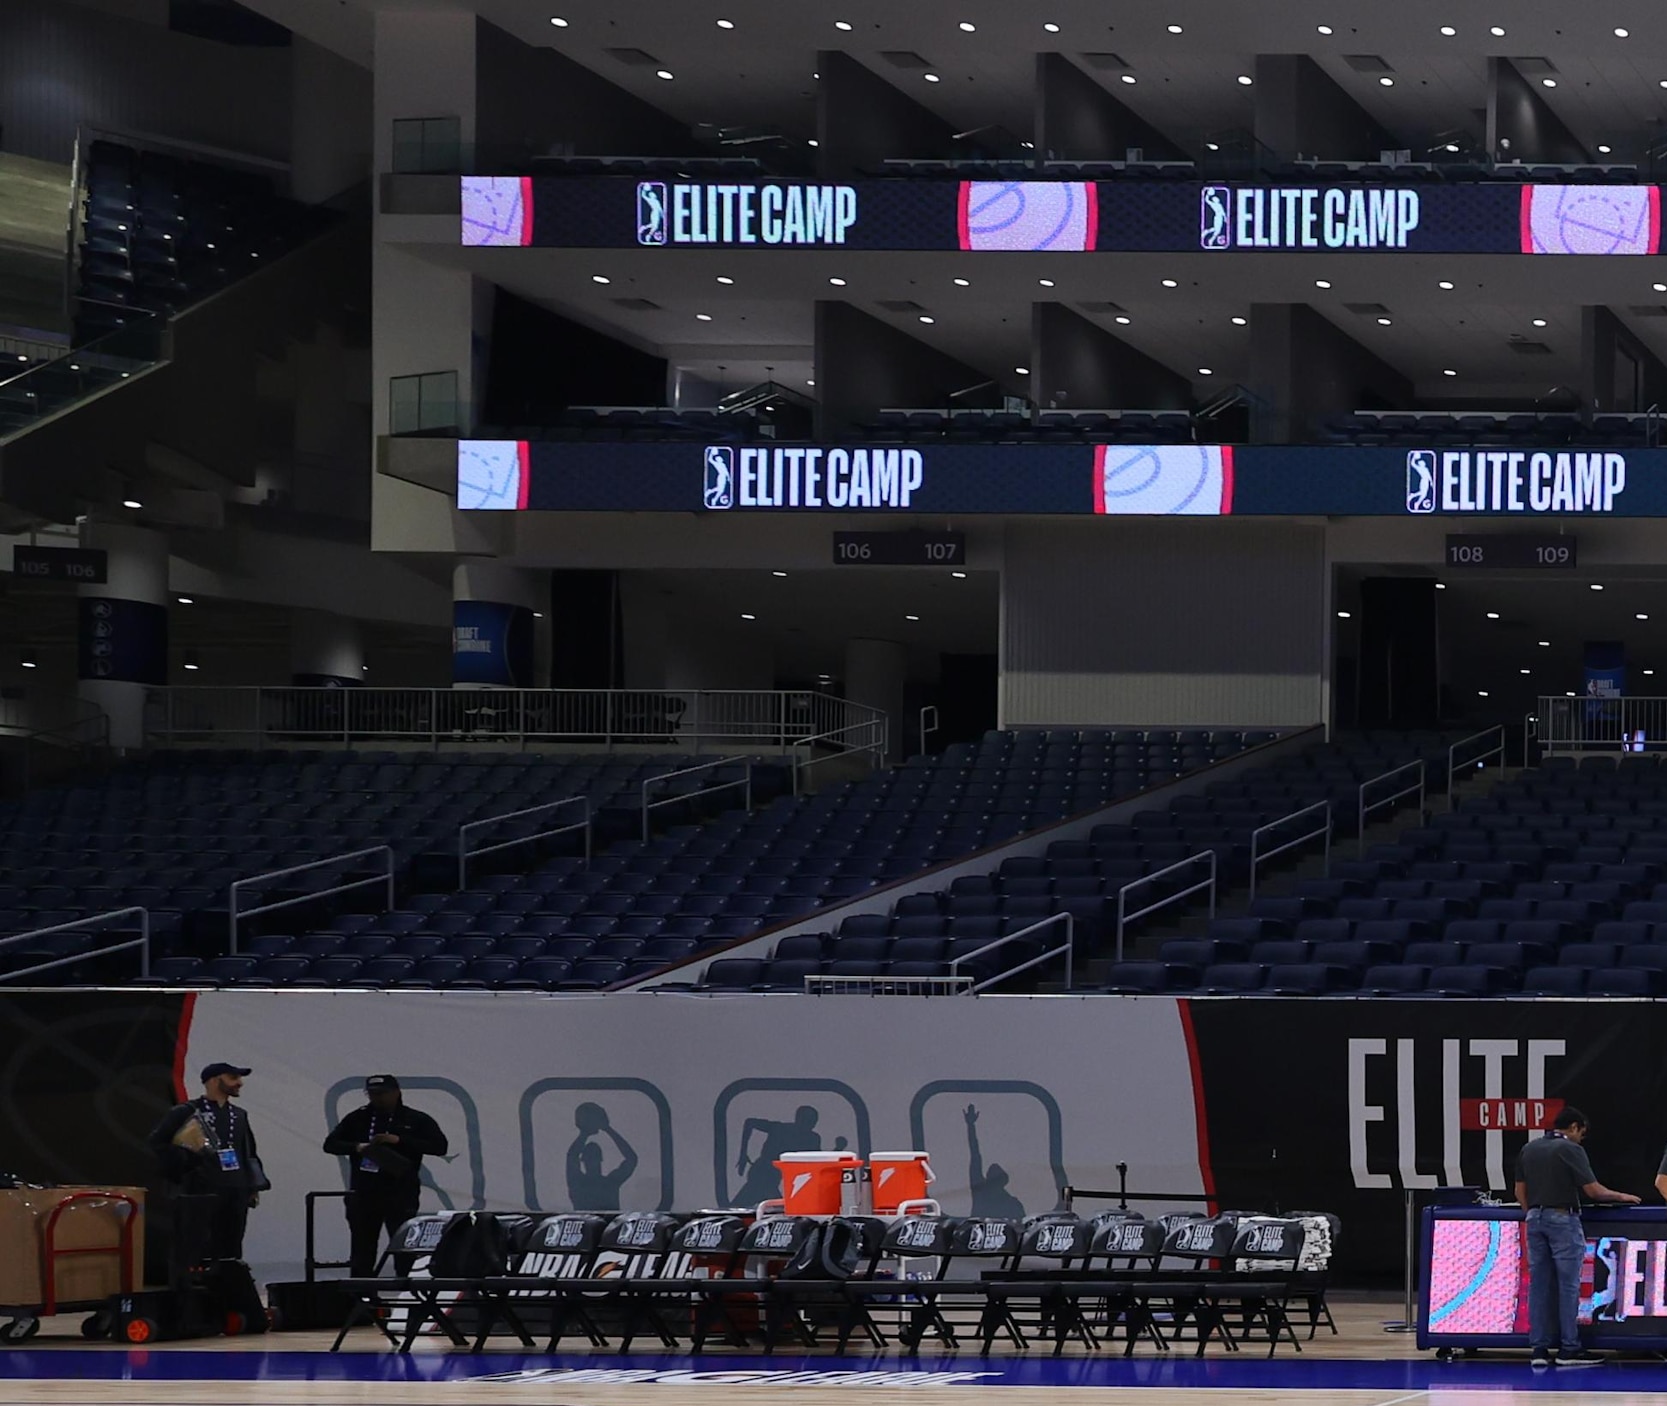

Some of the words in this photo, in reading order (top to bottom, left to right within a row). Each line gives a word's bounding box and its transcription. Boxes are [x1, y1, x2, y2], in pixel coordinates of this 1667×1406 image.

[673, 185, 755, 244] ELITE
[762, 185, 856, 244] CAMP
[1236, 189, 1318, 247] ELITE
[1324, 189, 1418, 247] CAMP
[739, 449, 822, 507] ELITE
[828, 449, 922, 507] CAMP
[1442, 453, 1524, 512] ELITE
[1530, 453, 1625, 512] CAMP
[838, 542, 871, 560] 106
[925, 542, 957, 560] 107
[1450, 546, 1484, 563] 108
[1536, 546, 1569, 564] 109
[20, 560, 50, 576] 105
[65, 562, 95, 578] 106
[1479, 1102, 1545, 1127] CAMP
[564, 1220, 585, 1234] ELITE
[636, 1219, 656, 1232] ELITE
[703, 1221, 724, 1234] ELITE
[774, 1222, 795, 1234] ELITE
[917, 1220, 938, 1233] ELITE
[985, 1223, 1006, 1235] ELITE
[1054, 1225, 1075, 1238] ELITE
[1124, 1225, 1144, 1238] ELITE
[1194, 1225, 1214, 1238] ELITE
[1263, 1226, 1284, 1238] ELITE
[560, 1234, 582, 1246] CAMP
[699, 1234, 722, 1247] CAMP
[769, 1234, 793, 1247] CAMP
[912, 1233, 935, 1246] CAMP
[983, 1235, 1006, 1248] CAMP
[1051, 1238, 1074, 1251] CAMP
[1121, 1238, 1144, 1250] CAMP
[1190, 1237, 1214, 1250] CAMP
[1261, 1238, 1283, 1251] CAMP
